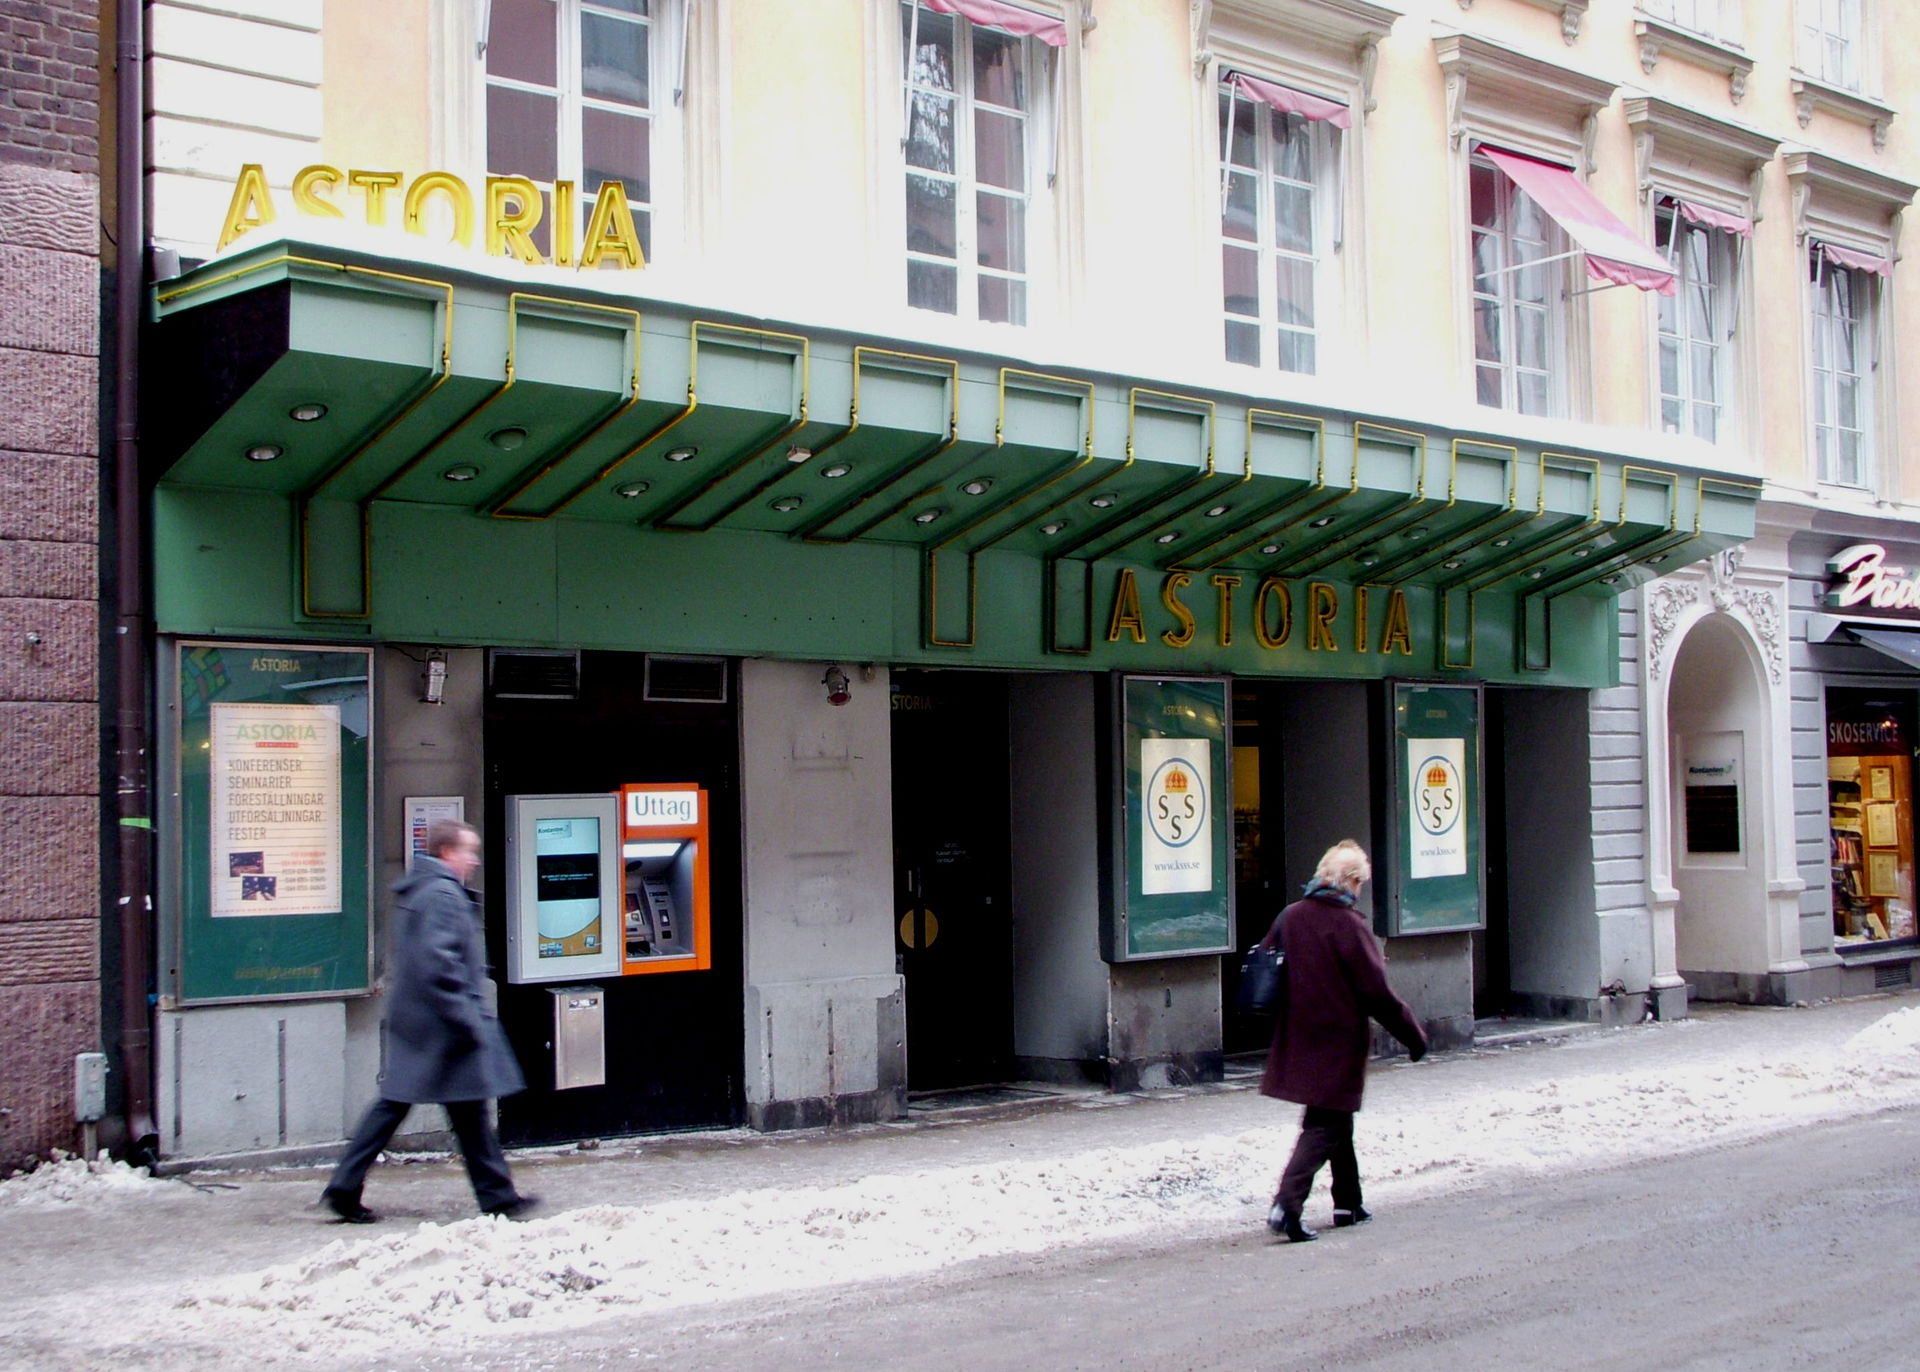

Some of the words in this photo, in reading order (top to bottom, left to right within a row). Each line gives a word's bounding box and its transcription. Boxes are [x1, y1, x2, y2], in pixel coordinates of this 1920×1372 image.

[216, 163, 646, 269] ASTORIA
[1723, 550, 1735, 576] 15
[1107, 567, 1413, 656] ASTORIA
[251, 657, 302, 672] ASTORIA
[889, 693, 932, 711] STORIA
[236, 723, 317, 741] ASTORIA
[1829, 721, 1899, 744] SKOSERVICE
[228, 758, 302, 772] KONFERENSER
[228, 775, 293, 789] SEMINARIER
[634, 795, 691, 821] Uttag
[228, 827, 267, 841] FESTER
